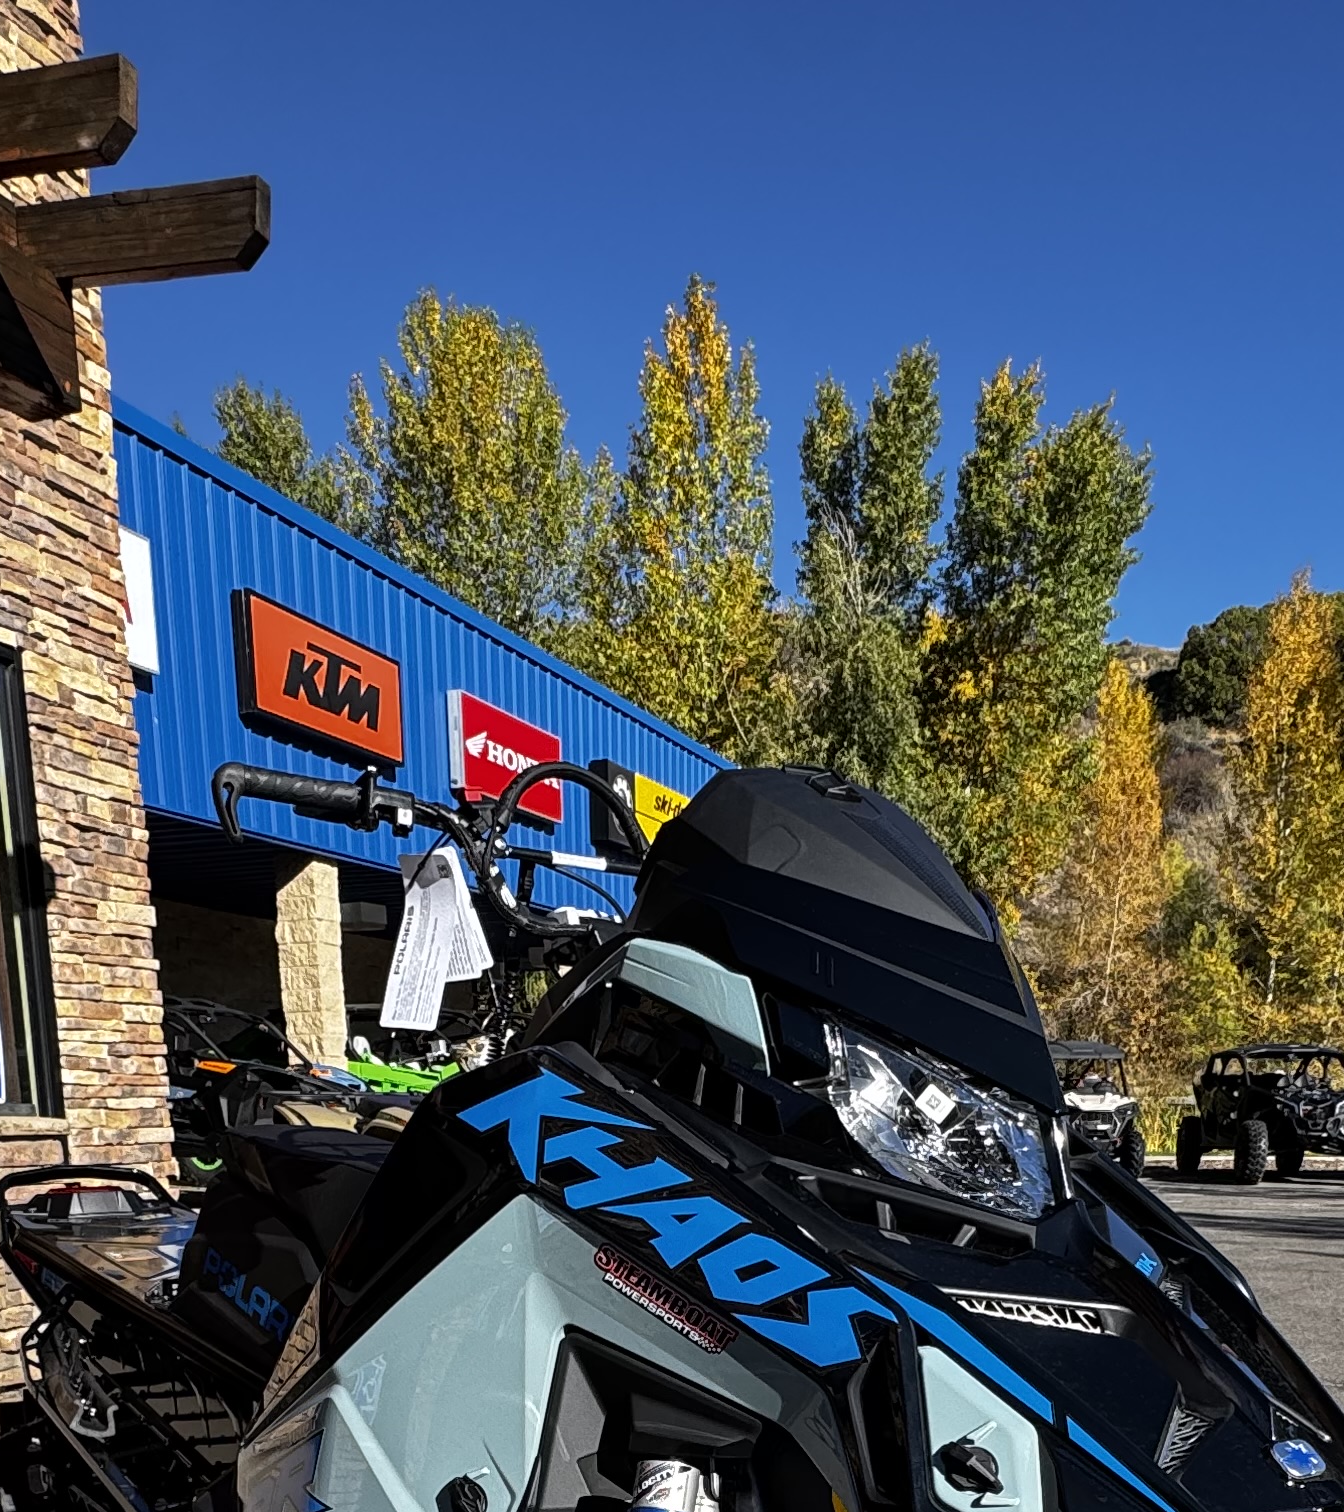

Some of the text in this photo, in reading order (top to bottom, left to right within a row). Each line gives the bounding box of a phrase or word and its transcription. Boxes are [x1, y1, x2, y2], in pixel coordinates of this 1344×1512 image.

[283, 641, 380, 732] KTM
[394, 905, 414, 975] POLARIS
[456, 1067, 899, 1367] KHAOS
[202, 1246, 294, 1342] POLAR
[595, 1245, 736, 1347] STEAMBOAT
[604, 1272, 703, 1342] POWERSPORTS
